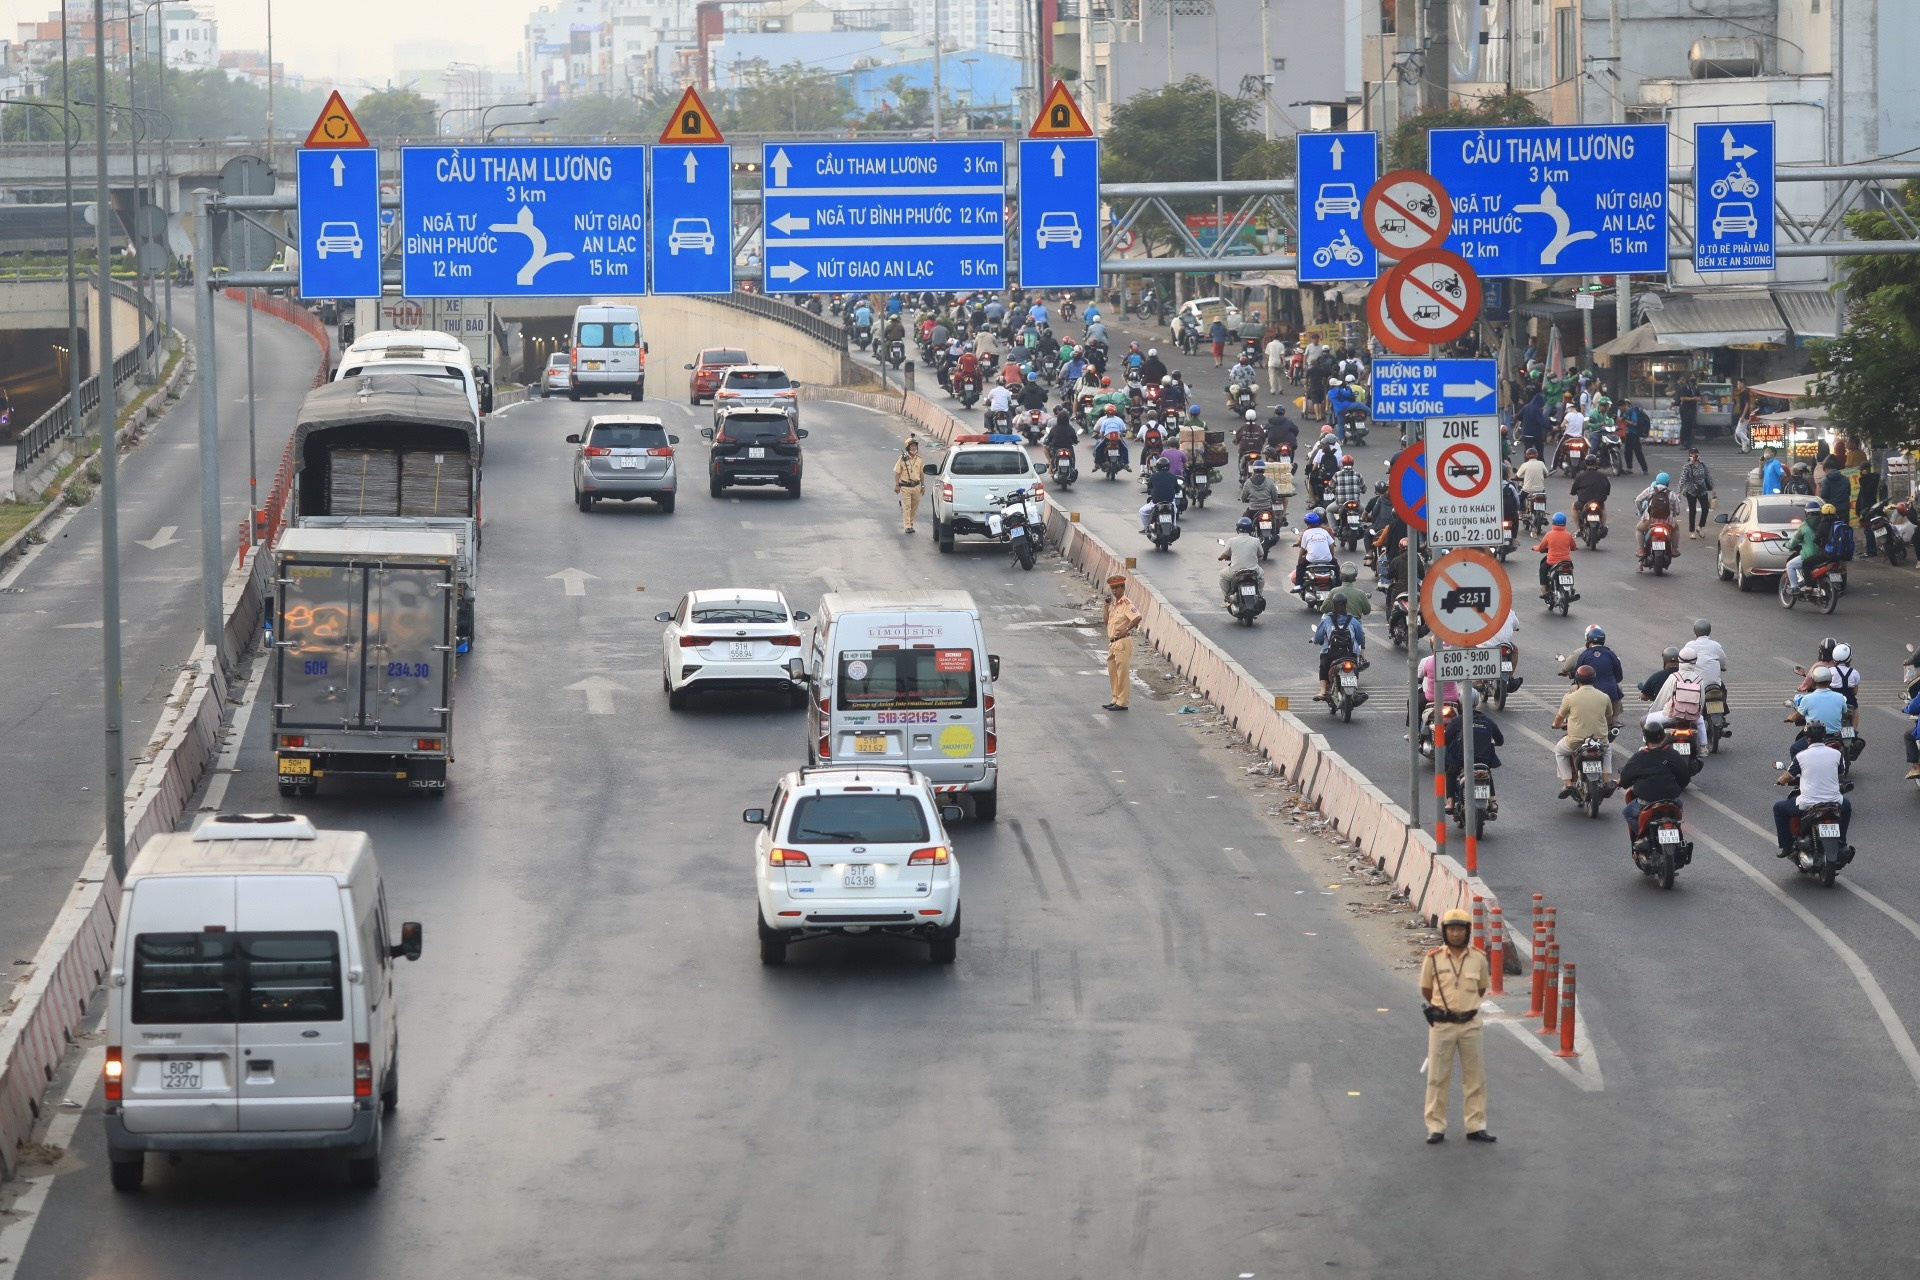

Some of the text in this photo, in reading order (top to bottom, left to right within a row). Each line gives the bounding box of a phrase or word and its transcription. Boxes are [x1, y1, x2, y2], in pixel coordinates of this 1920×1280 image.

[1462, 130, 1634, 164] CẦU THAM LƯƠNG
[436, 147, 612, 183] CẦU THAM LƯƠNG
[816, 152, 998, 175] CẦU THAM LƯƠNG 3 Km
[1529, 166, 1569, 183] 3 km
[506, 185, 546, 203] 3 km
[1596, 188, 1626, 210] NÚT
[1449, 192, 1502, 214] NGÃ TƯ
[423, 212, 478, 232] NGÃ TƯ
[574, 211, 642, 231] NÚT GIAO
[816, 203, 998, 226] NGÃ TƯ BÌNH PHƯỚC 12 Km
[1602, 213, 1655, 233] AN LẠC
[1472, 212, 1523, 235] PHƯỚC
[407, 232, 498, 254] BÌNH PHƯỚC
[582, 235, 637, 256] AN LẠC
[1460, 241, 1499, 259] 12 km
[1609, 237, 1648, 254] 15 km
[1699, 241, 1770, 255] Ô TÔ RẼ PHẢI VÀO
[432, 260, 472, 277] 12 km
[589, 259, 628, 276] 15 km
[817, 257, 998, 279] NÚT GIAO AN LẠC 15 Km
[1698, 254, 1771, 267] BẾN XE AN SƯƠNG
[446, 300, 460, 312] XE
[466, 318, 484, 332] BÁO
[1376, 363, 1437, 379] HƯỚNG ĐI
[1381, 380, 1430, 396] BẾN XE
[1376, 398, 1444, 414] AN SƯƠNG
[1442, 420, 1479, 438] ZONE
[1450, 504, 1456, 513] Ô
[1458, 504, 1468, 513] TÔ
[1470, 502, 1496, 512] KHÁCH
[1437, 516, 1446, 526] CÓ
[1449, 516, 1478, 526] GIƯỜNG
[1480, 592, 1486, 602] T
[1444, 652, 1462, 663] 6:00
[1470, 650, 1489, 661] 9:00
[304, 660, 328, 674] 50H
[387, 662, 429, 677] 234.30
[1441, 666, 1463, 677] 16:00
[1472, 664, 1496, 675] 20:00
[851, 866, 867, 876] 51F
[845, 876, 875, 886] 043.98
[170, 1062, 193, 1074] 60P
[166, 1074, 198, 1087] 2370
